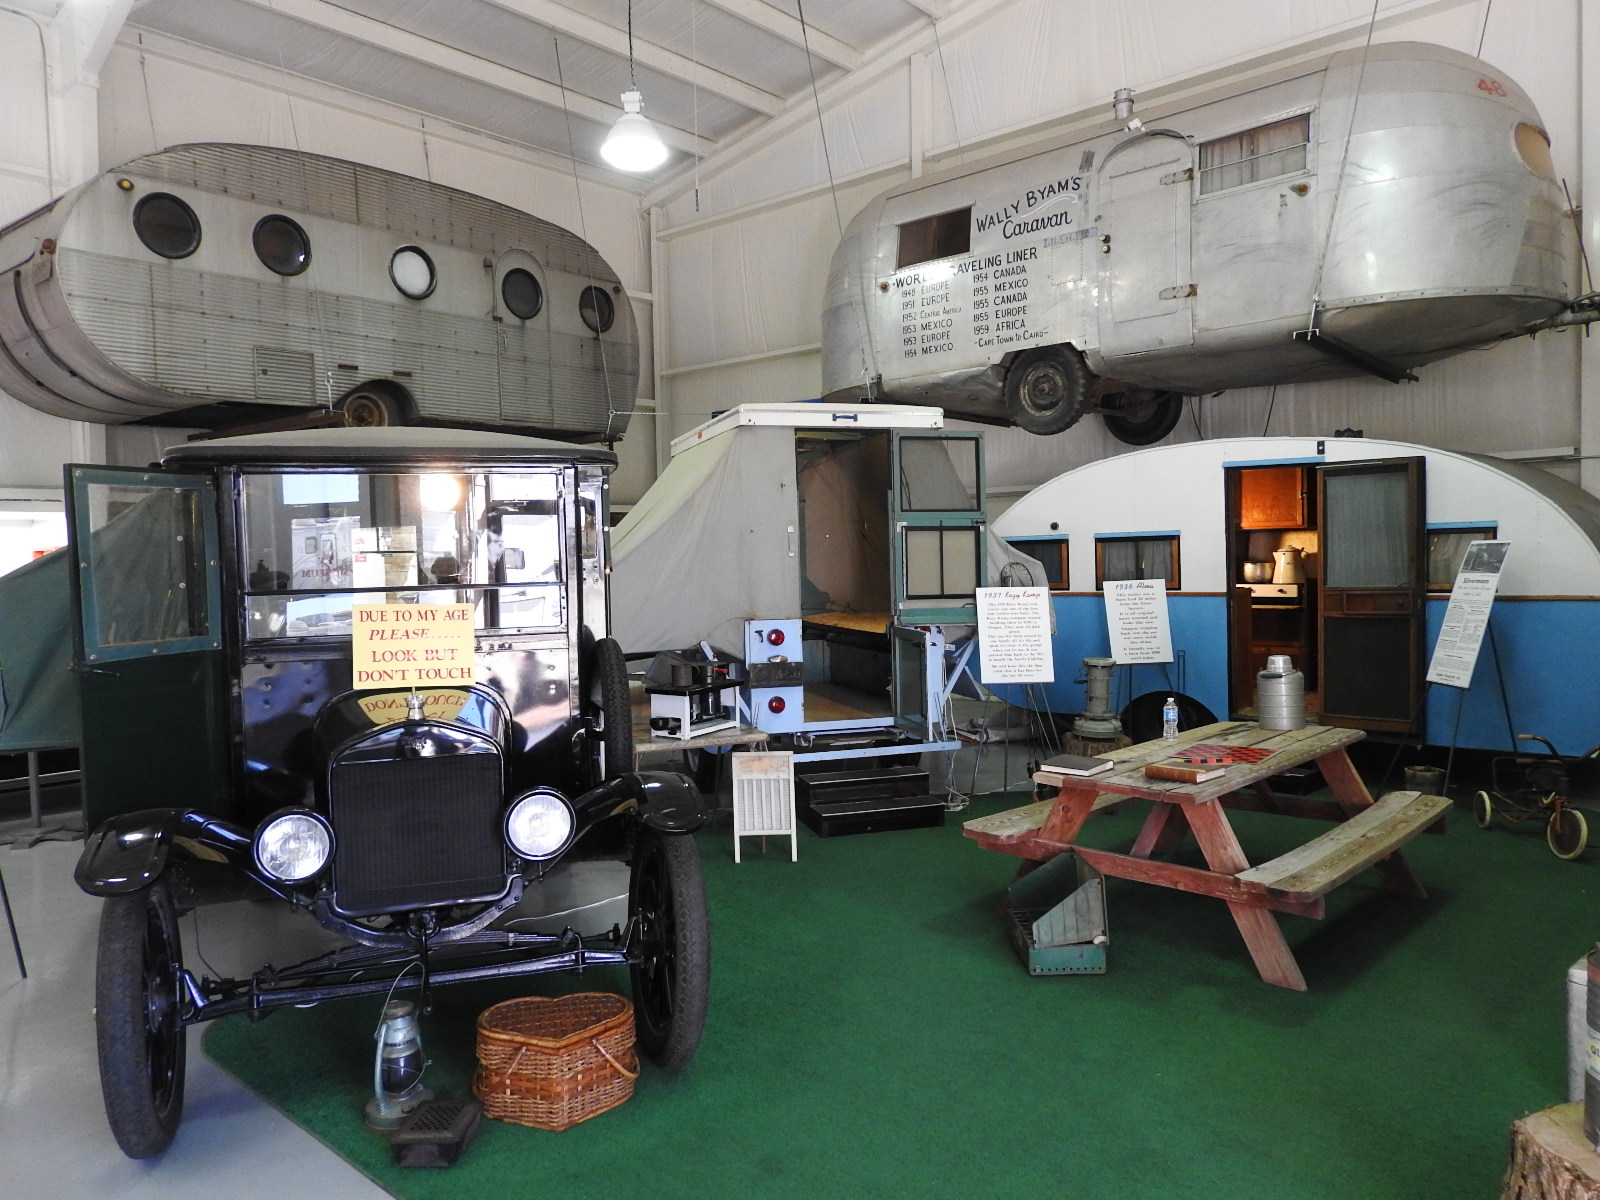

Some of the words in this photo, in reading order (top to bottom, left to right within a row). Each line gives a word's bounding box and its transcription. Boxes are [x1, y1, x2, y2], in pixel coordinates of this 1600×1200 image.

[976, 200, 1020, 233] WALLY
[1026, 176, 1081, 208] BYAM'S
[1003, 211, 1073, 239] Caravan
[895, 272, 935, 288] WORL
[945, 254, 1002, 277] RAVELING
[1006, 247, 1038, 264] LINER
[973, 272, 988, 284] 1954
[993, 265, 1027, 279] CANADA
[902, 288, 916, 298] 1948
[921, 280, 950, 294] EUROPE
[973, 285, 989, 296] 1955
[994, 279, 1029, 293] MEXICO
[902, 300, 915, 310] 1951
[921, 293, 950, 307] EUROPE
[973, 299, 989, 310] 1955
[993, 292, 1028, 306] CANADA
[902, 312, 917, 322] 1952
[973, 312, 989, 323] 1955
[995, 305, 1028, 319] EUROPE
[902, 326, 917, 335] 1953
[920, 319, 953, 332] MEXICO
[974, 325, 989, 336] 1959
[995, 319, 1026, 332] AFRICA
[903, 337, 917, 346] 1953
[921, 331, 951, 344] EUROPE
[921, 342, 954, 355] MEXICO
[359, 610, 388, 622] DUE
[393, 610, 412, 622] TO
[417, 610, 438, 621] MY
[443, 609, 469, 621] AGE
[372, 650, 417, 663] LOOK
[425, 649, 458, 661] BUT
[358, 669, 409, 683] DON'T
[415, 667, 472, 680] TOUCH
